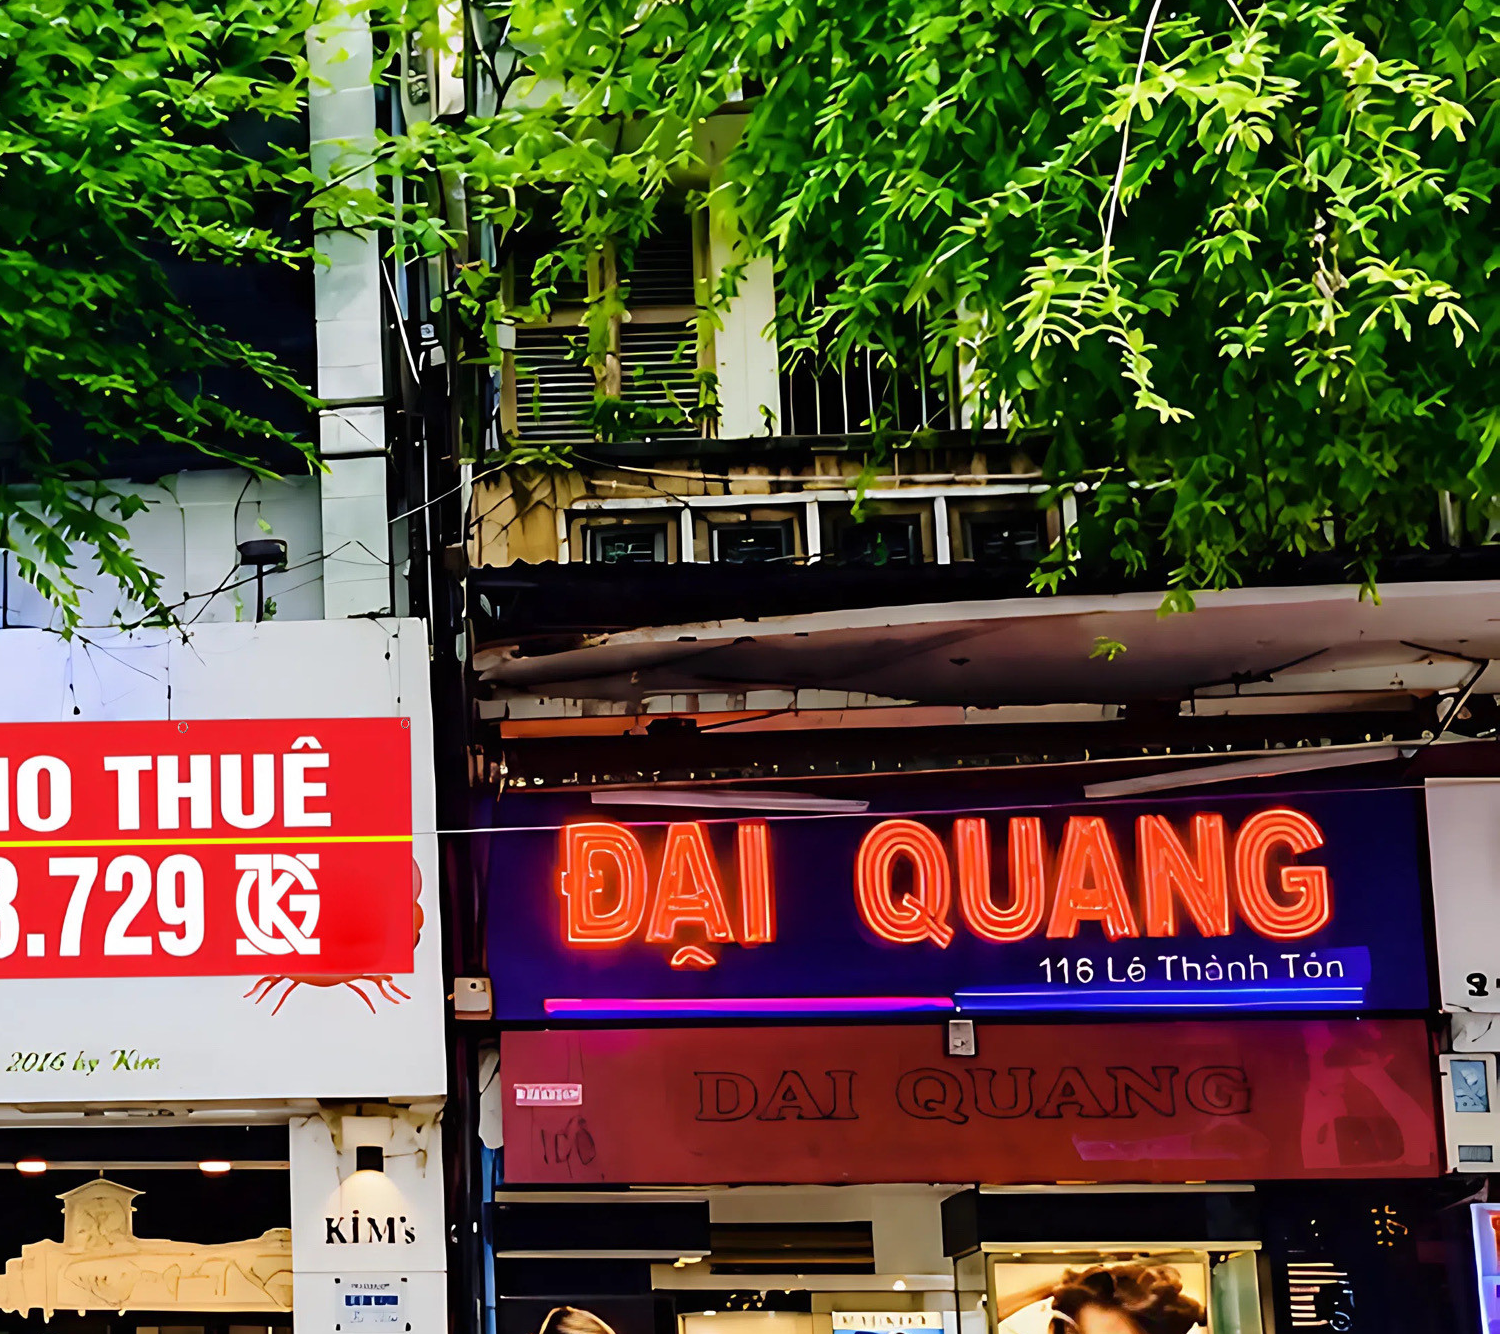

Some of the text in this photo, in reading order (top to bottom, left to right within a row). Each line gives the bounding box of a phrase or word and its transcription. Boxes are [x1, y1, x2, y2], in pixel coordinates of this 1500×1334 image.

[103, 735, 332, 831] THUÊ
[853, 808, 1331, 949] QUANG
[1039, 957, 1094, 984] 116
[895, 1067, 1252, 1125] QUANG
